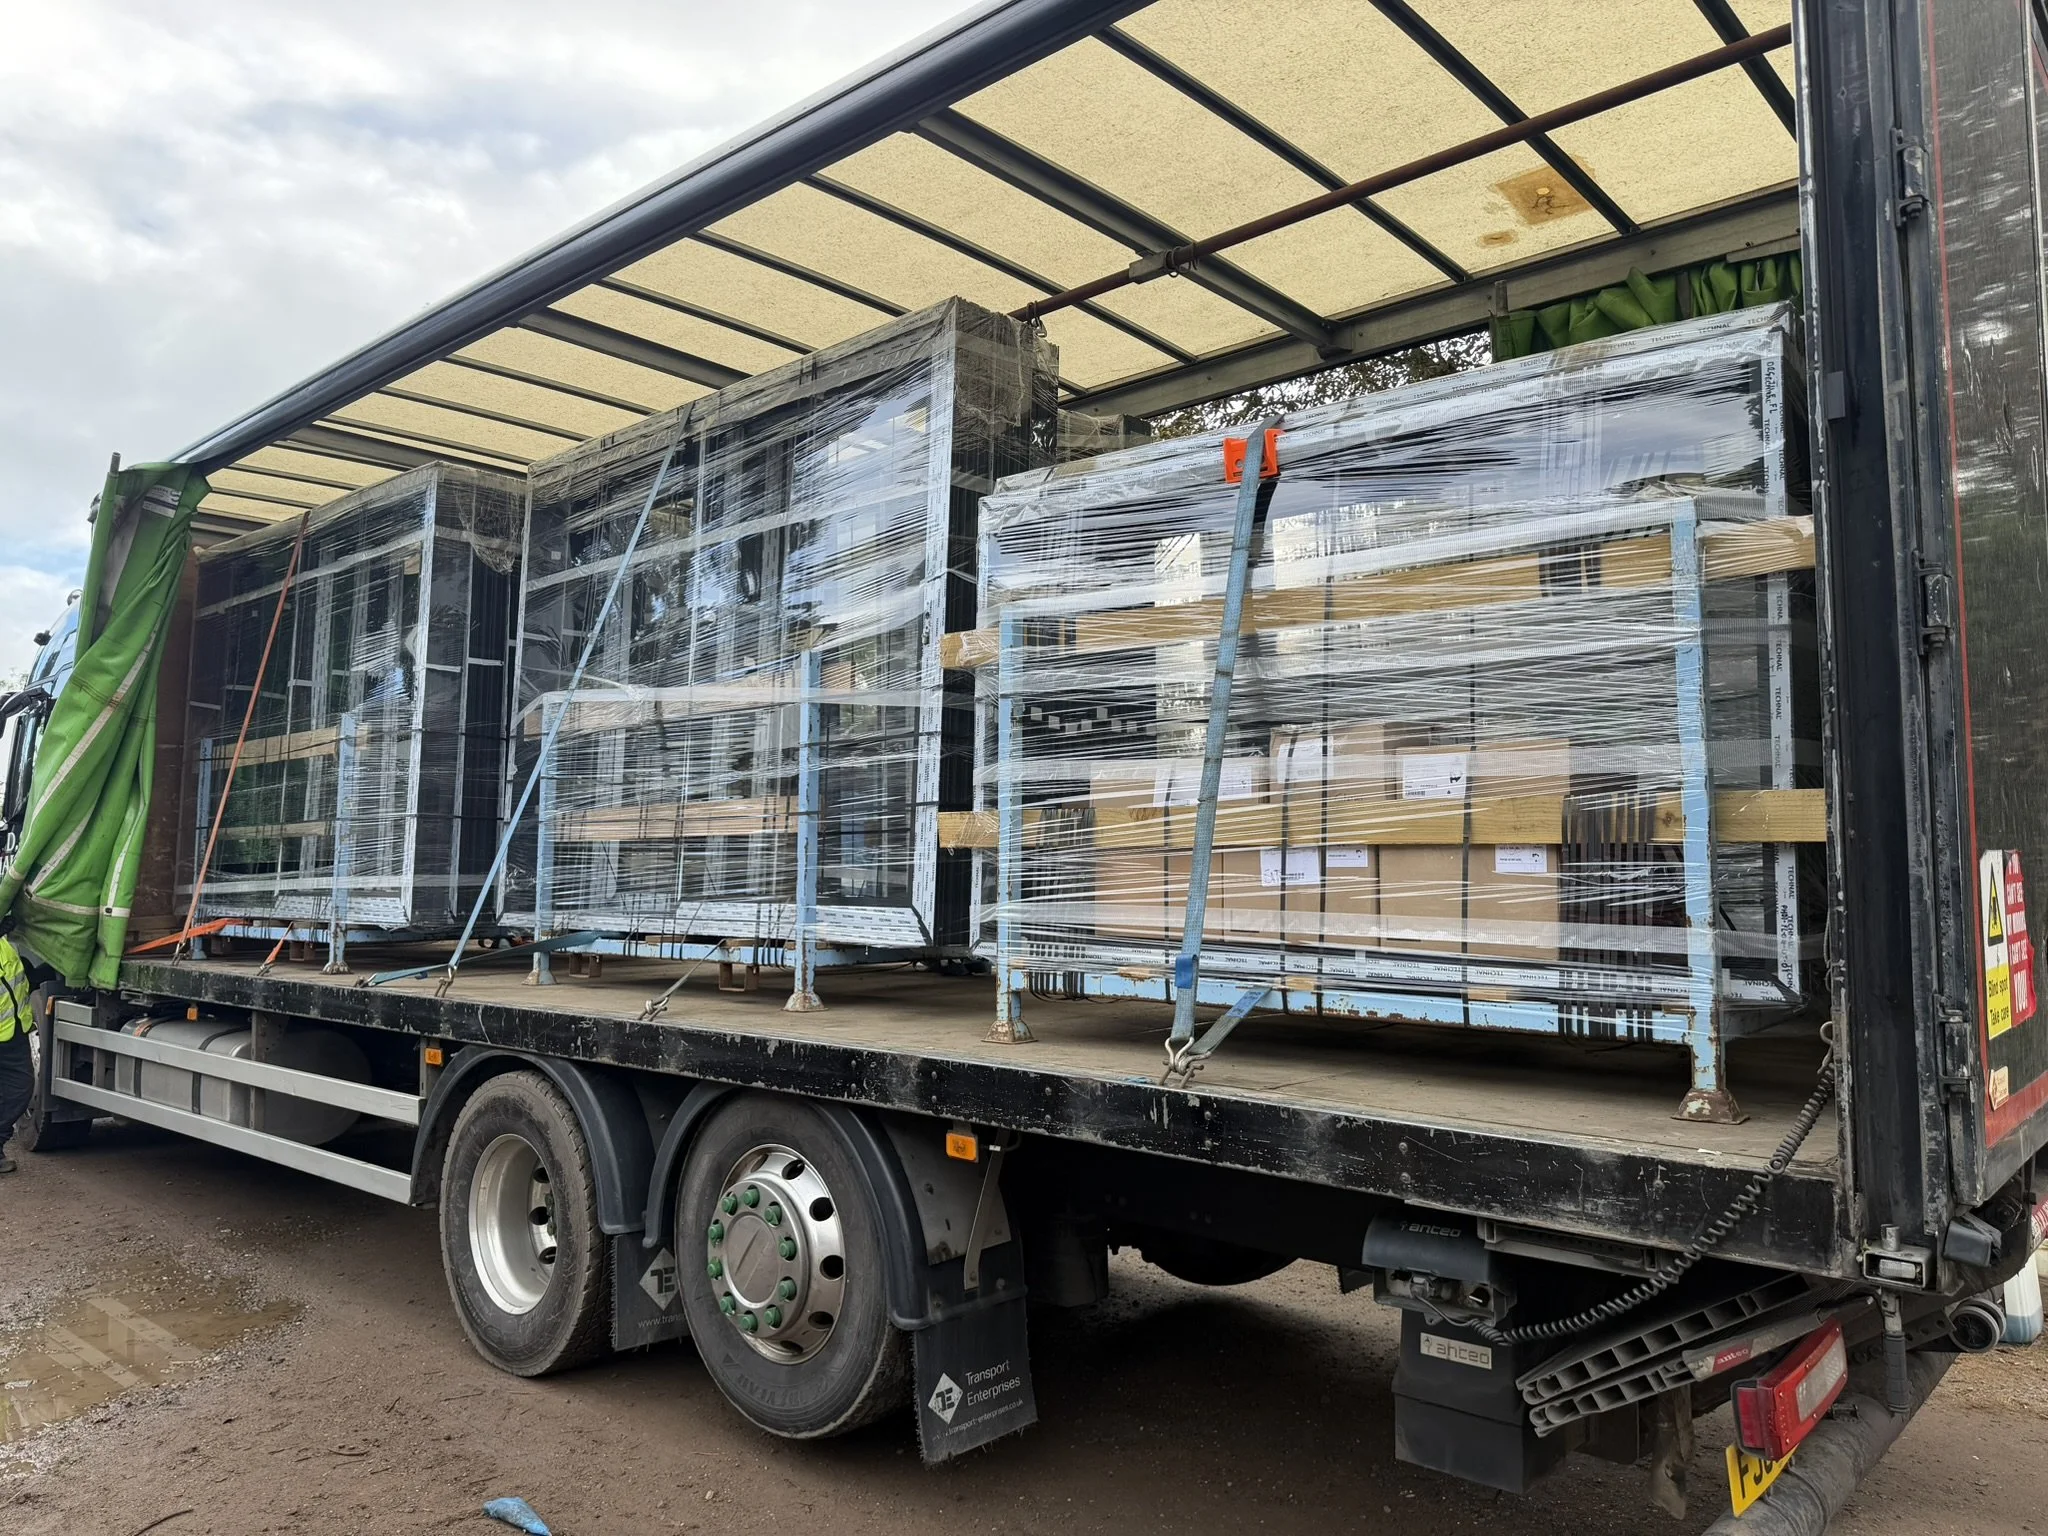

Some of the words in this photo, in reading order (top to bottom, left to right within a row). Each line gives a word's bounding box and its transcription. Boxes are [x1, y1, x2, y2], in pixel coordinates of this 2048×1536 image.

[1988, 980, 1999, 998] Blind
[1999, 977, 2009, 997] spot
[1989, 1009, 2000, 1027] Take
[2000, 1006, 2010, 1022] care
[1409, 1223, 1462, 1238] anteo
[1717, 1348, 1749, 1366] anteo
[965, 1359, 1011, 1386] Transport
[966, 1376, 1021, 1407] Enterprises
[931, 1398, 1024, 1442] .transport-enterprises.co.uk
